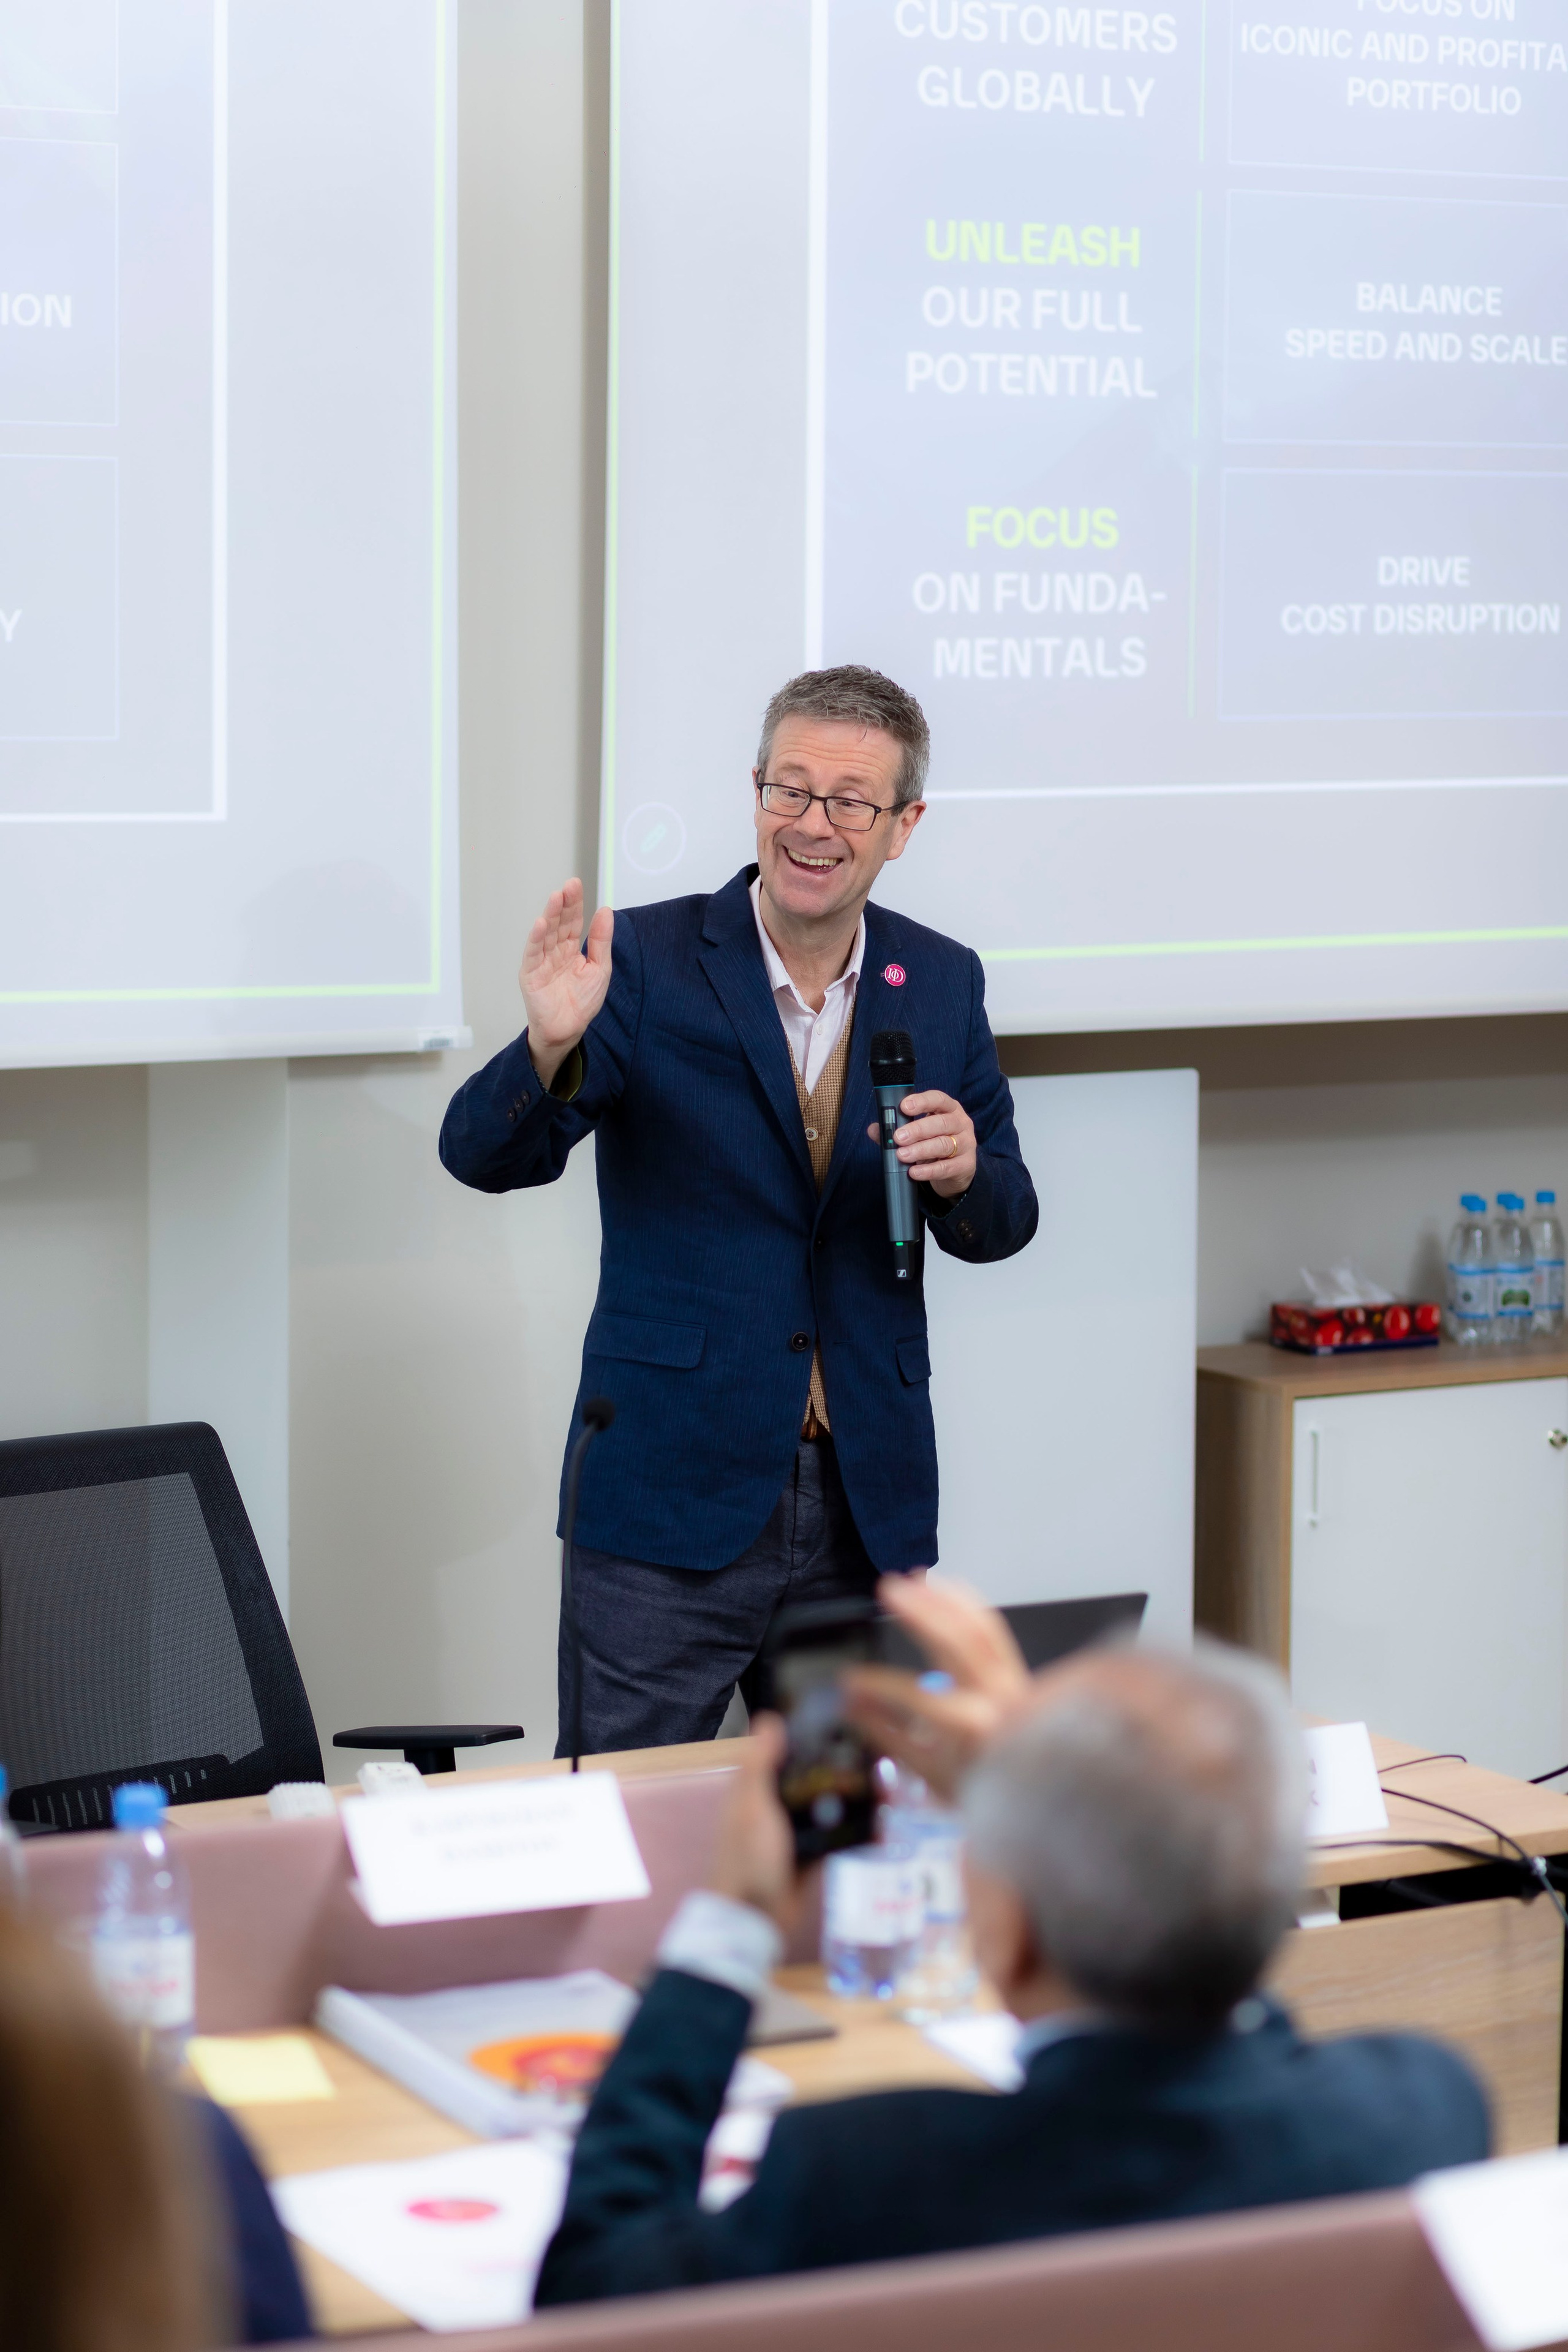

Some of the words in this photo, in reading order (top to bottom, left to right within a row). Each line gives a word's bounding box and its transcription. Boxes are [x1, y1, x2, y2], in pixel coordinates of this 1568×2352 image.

[894, 0, 1178, 54] CUSTOMERS
[1469, 0, 1515, 22] ON
[1241, 23, 1353, 59] ICONIC
[1360, 31, 1430, 64] AND
[1437, 34, 1567, 72] PROFITA
[917, 64, 1155, 118] GLOBALLY
[1346, 76, 1522, 115] PORTFOLIO
[926, 219, 1141, 268] UNLEASH
[922, 285, 1022, 330] OUR
[1032, 288, 1143, 333] FULL
[1356, 281, 1502, 316] BALANCE
[1285, 328, 1388, 360] SPEED
[1394, 331, 1463, 362] AND
[1469, 333, 1567, 365] SCALE
[907, 351, 1156, 398] POTENTIAL
[967, 506, 1120, 550] FOCUS
[1378, 556, 1469, 586] DRIVE
[913, 572, 980, 614] ON
[994, 572, 1166, 613] FUNDA-
[1281, 604, 1367, 635] COST
[1373, 603, 1560, 635] DISRUPTION
[934, 637, 1147, 679] MENTALS
